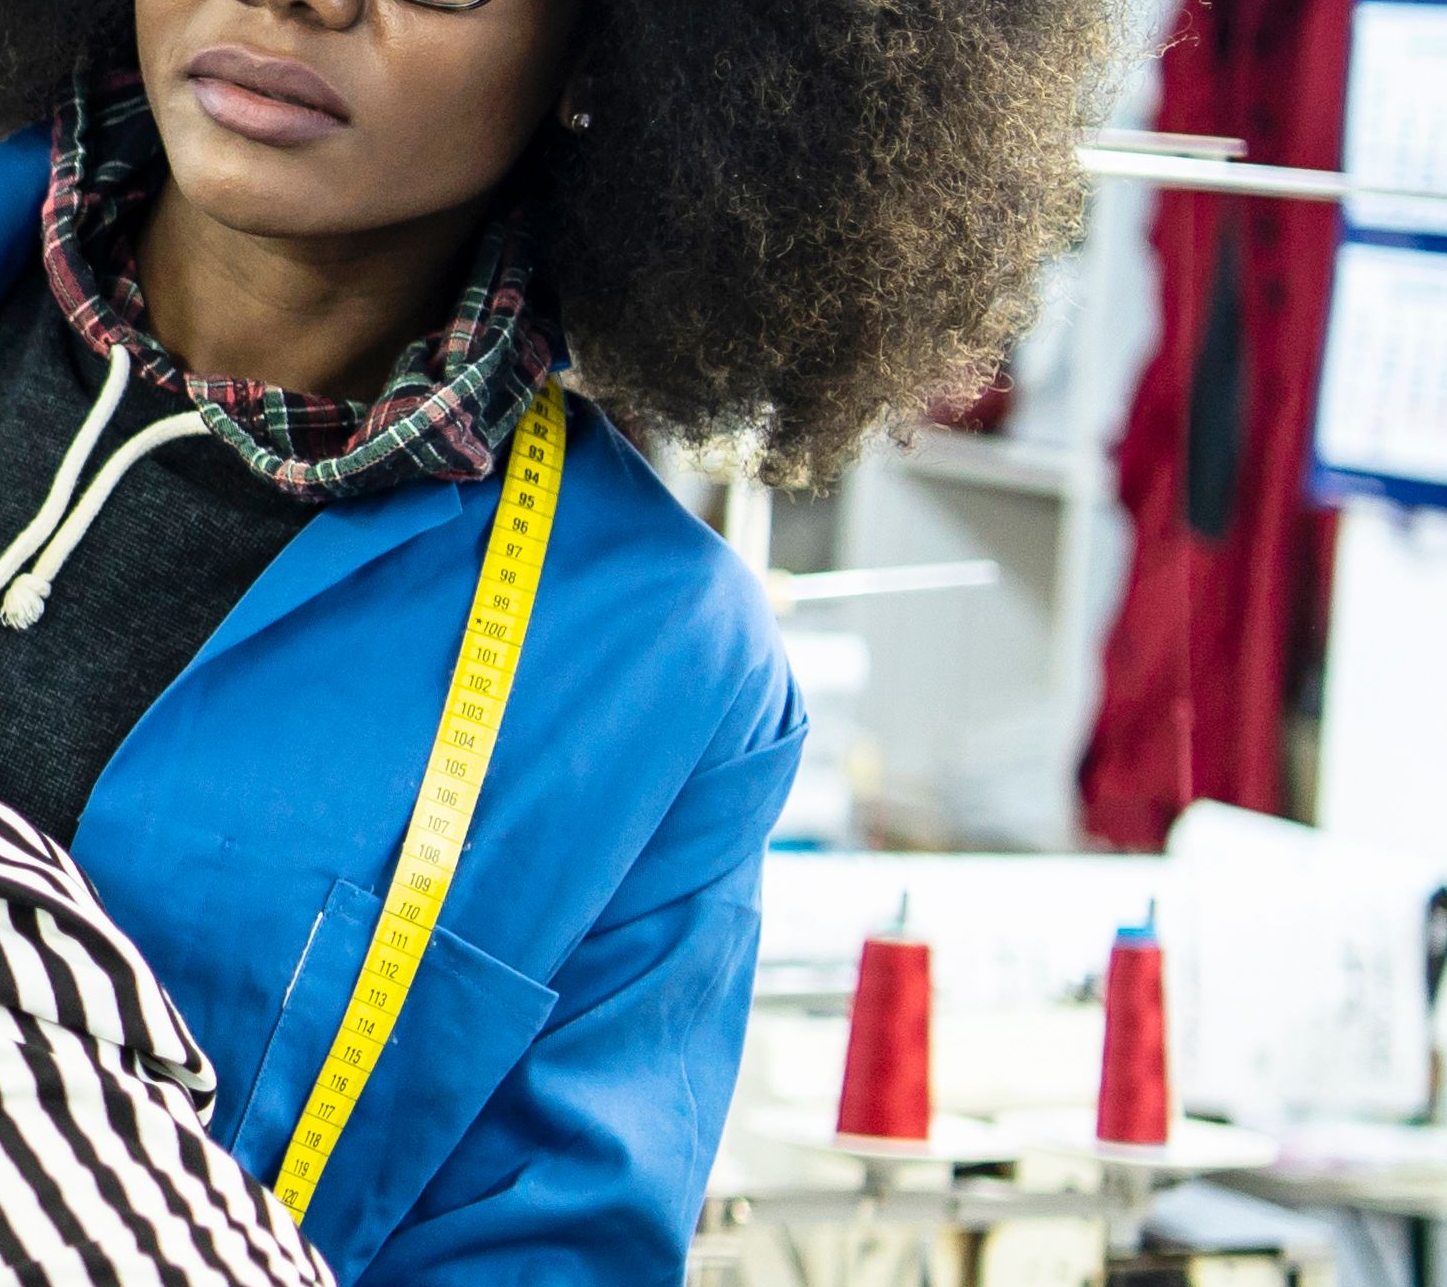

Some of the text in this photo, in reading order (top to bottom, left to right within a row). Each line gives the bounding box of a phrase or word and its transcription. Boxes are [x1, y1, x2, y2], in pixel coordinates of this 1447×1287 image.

[533, 422, 549, 440] 92
[528, 445, 544, 463] 93
[524, 468, 540, 485] 94
[519, 491, 535, 509] 95
[512, 517, 529, 535] 96
[506, 543, 523, 559] 97
[500, 568, 516, 584] 98
[493, 594, 510, 611] 99
[483, 621, 507, 638] 100
[476, 647, 497, 664] 101
[468, 674, 492, 693] 102
[460, 702, 484, 721] 103
[452, 729, 475, 749] 104
[444, 758, 466, 778] 105
[436, 786, 458, 806] 106
[427, 815, 450, 834] 107
[418, 843, 440, 864] 108
[409, 872, 431, 892] 109
[399, 901, 421, 920] 110
[390, 931, 408, 949] 111
[379, 960, 399, 979] 112
[368, 988, 388, 1007] 113
[357, 1017, 376, 1036] 114
[343, 1046, 361, 1064] 115
[330, 1074, 349, 1092] 116
[318, 1102, 336, 1120] 117
[305, 1130, 322, 1148] 118
[294, 1159, 310, 1177] 119
[282, 1188, 299, 1206] 120
